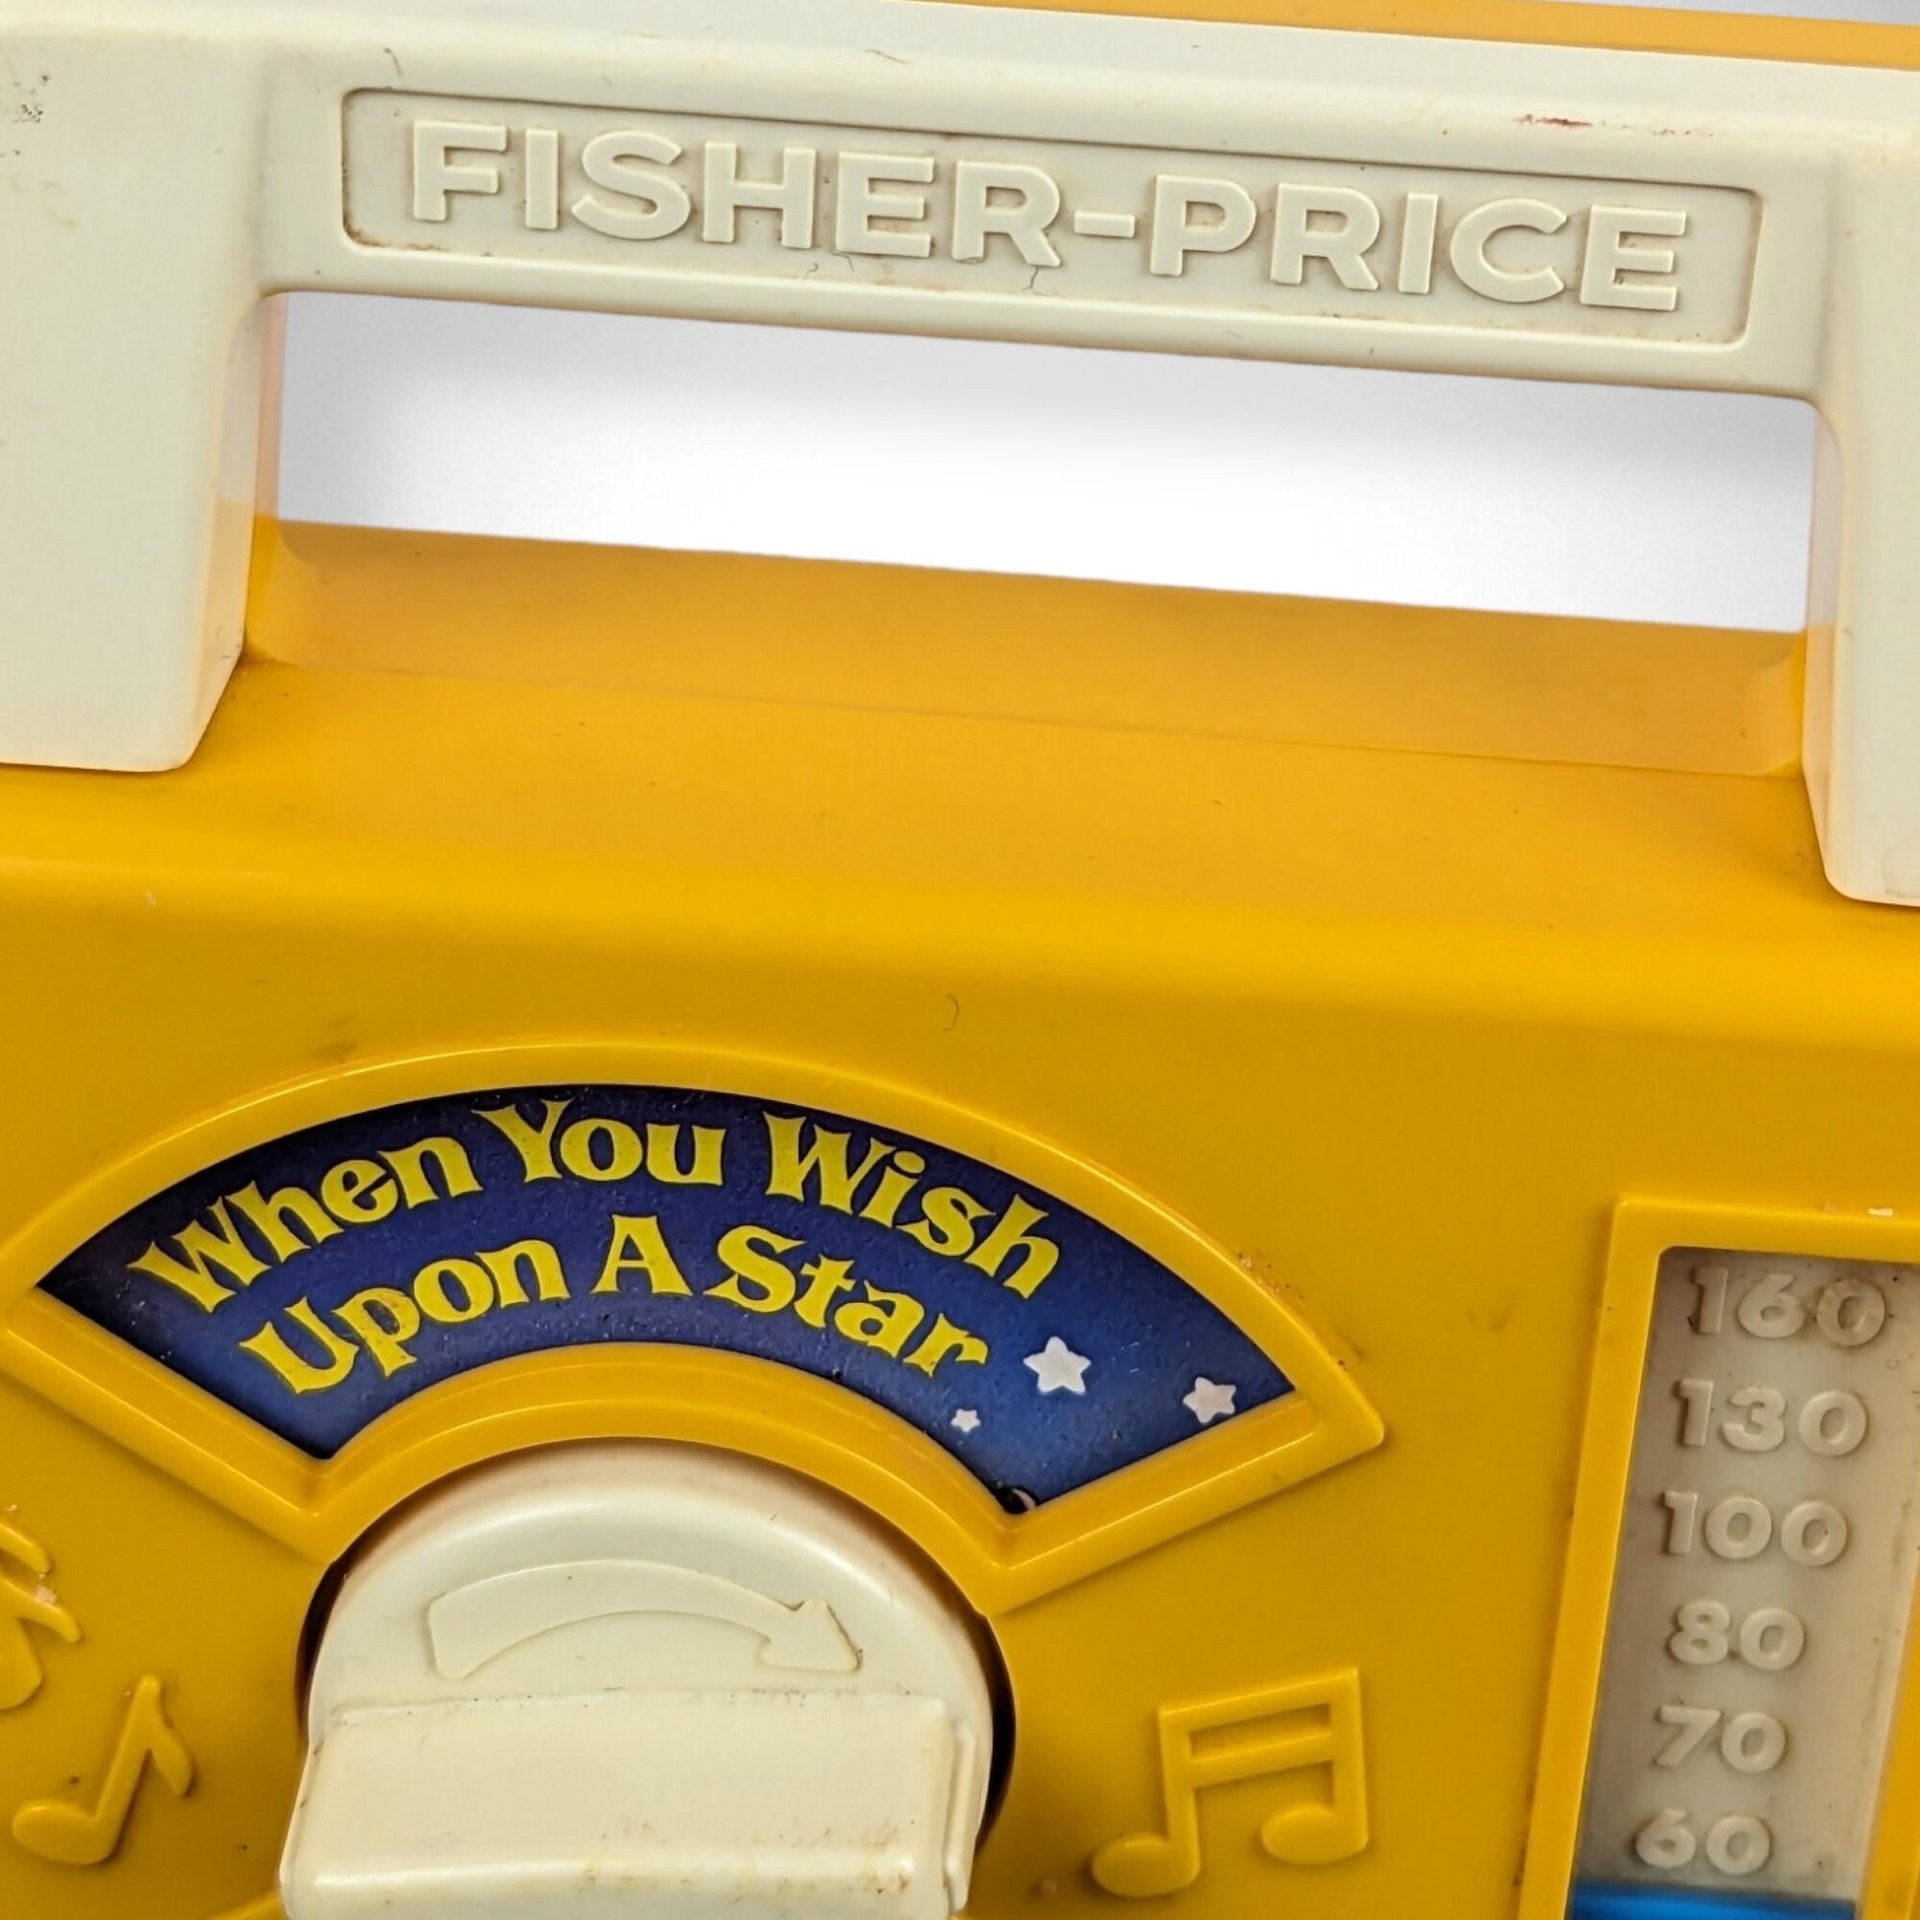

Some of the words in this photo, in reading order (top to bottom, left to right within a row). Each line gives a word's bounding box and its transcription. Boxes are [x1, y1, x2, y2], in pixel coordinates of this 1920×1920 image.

[413, 119, 1687, 312] FISHER-PRICE
[126, 1136, 484, 1314] When
[471, 1099, 726, 1186] You
[764, 1111, 1060, 1299] Wish
[239, 1238, 571, 1394] Upon
[590, 1214, 694, 1297] A
[704, 1224, 989, 1377] Star
[1691, 1266, 1887, 1347] 160
[1676, 1378, 1867, 1457] 130
[1661, 1490, 1848, 1566] 100
[1668, 1600, 1805, 1671] 80
[1654, 1704, 1787, 1773] 70
[1635, 1807, 1771, 1876] 60
